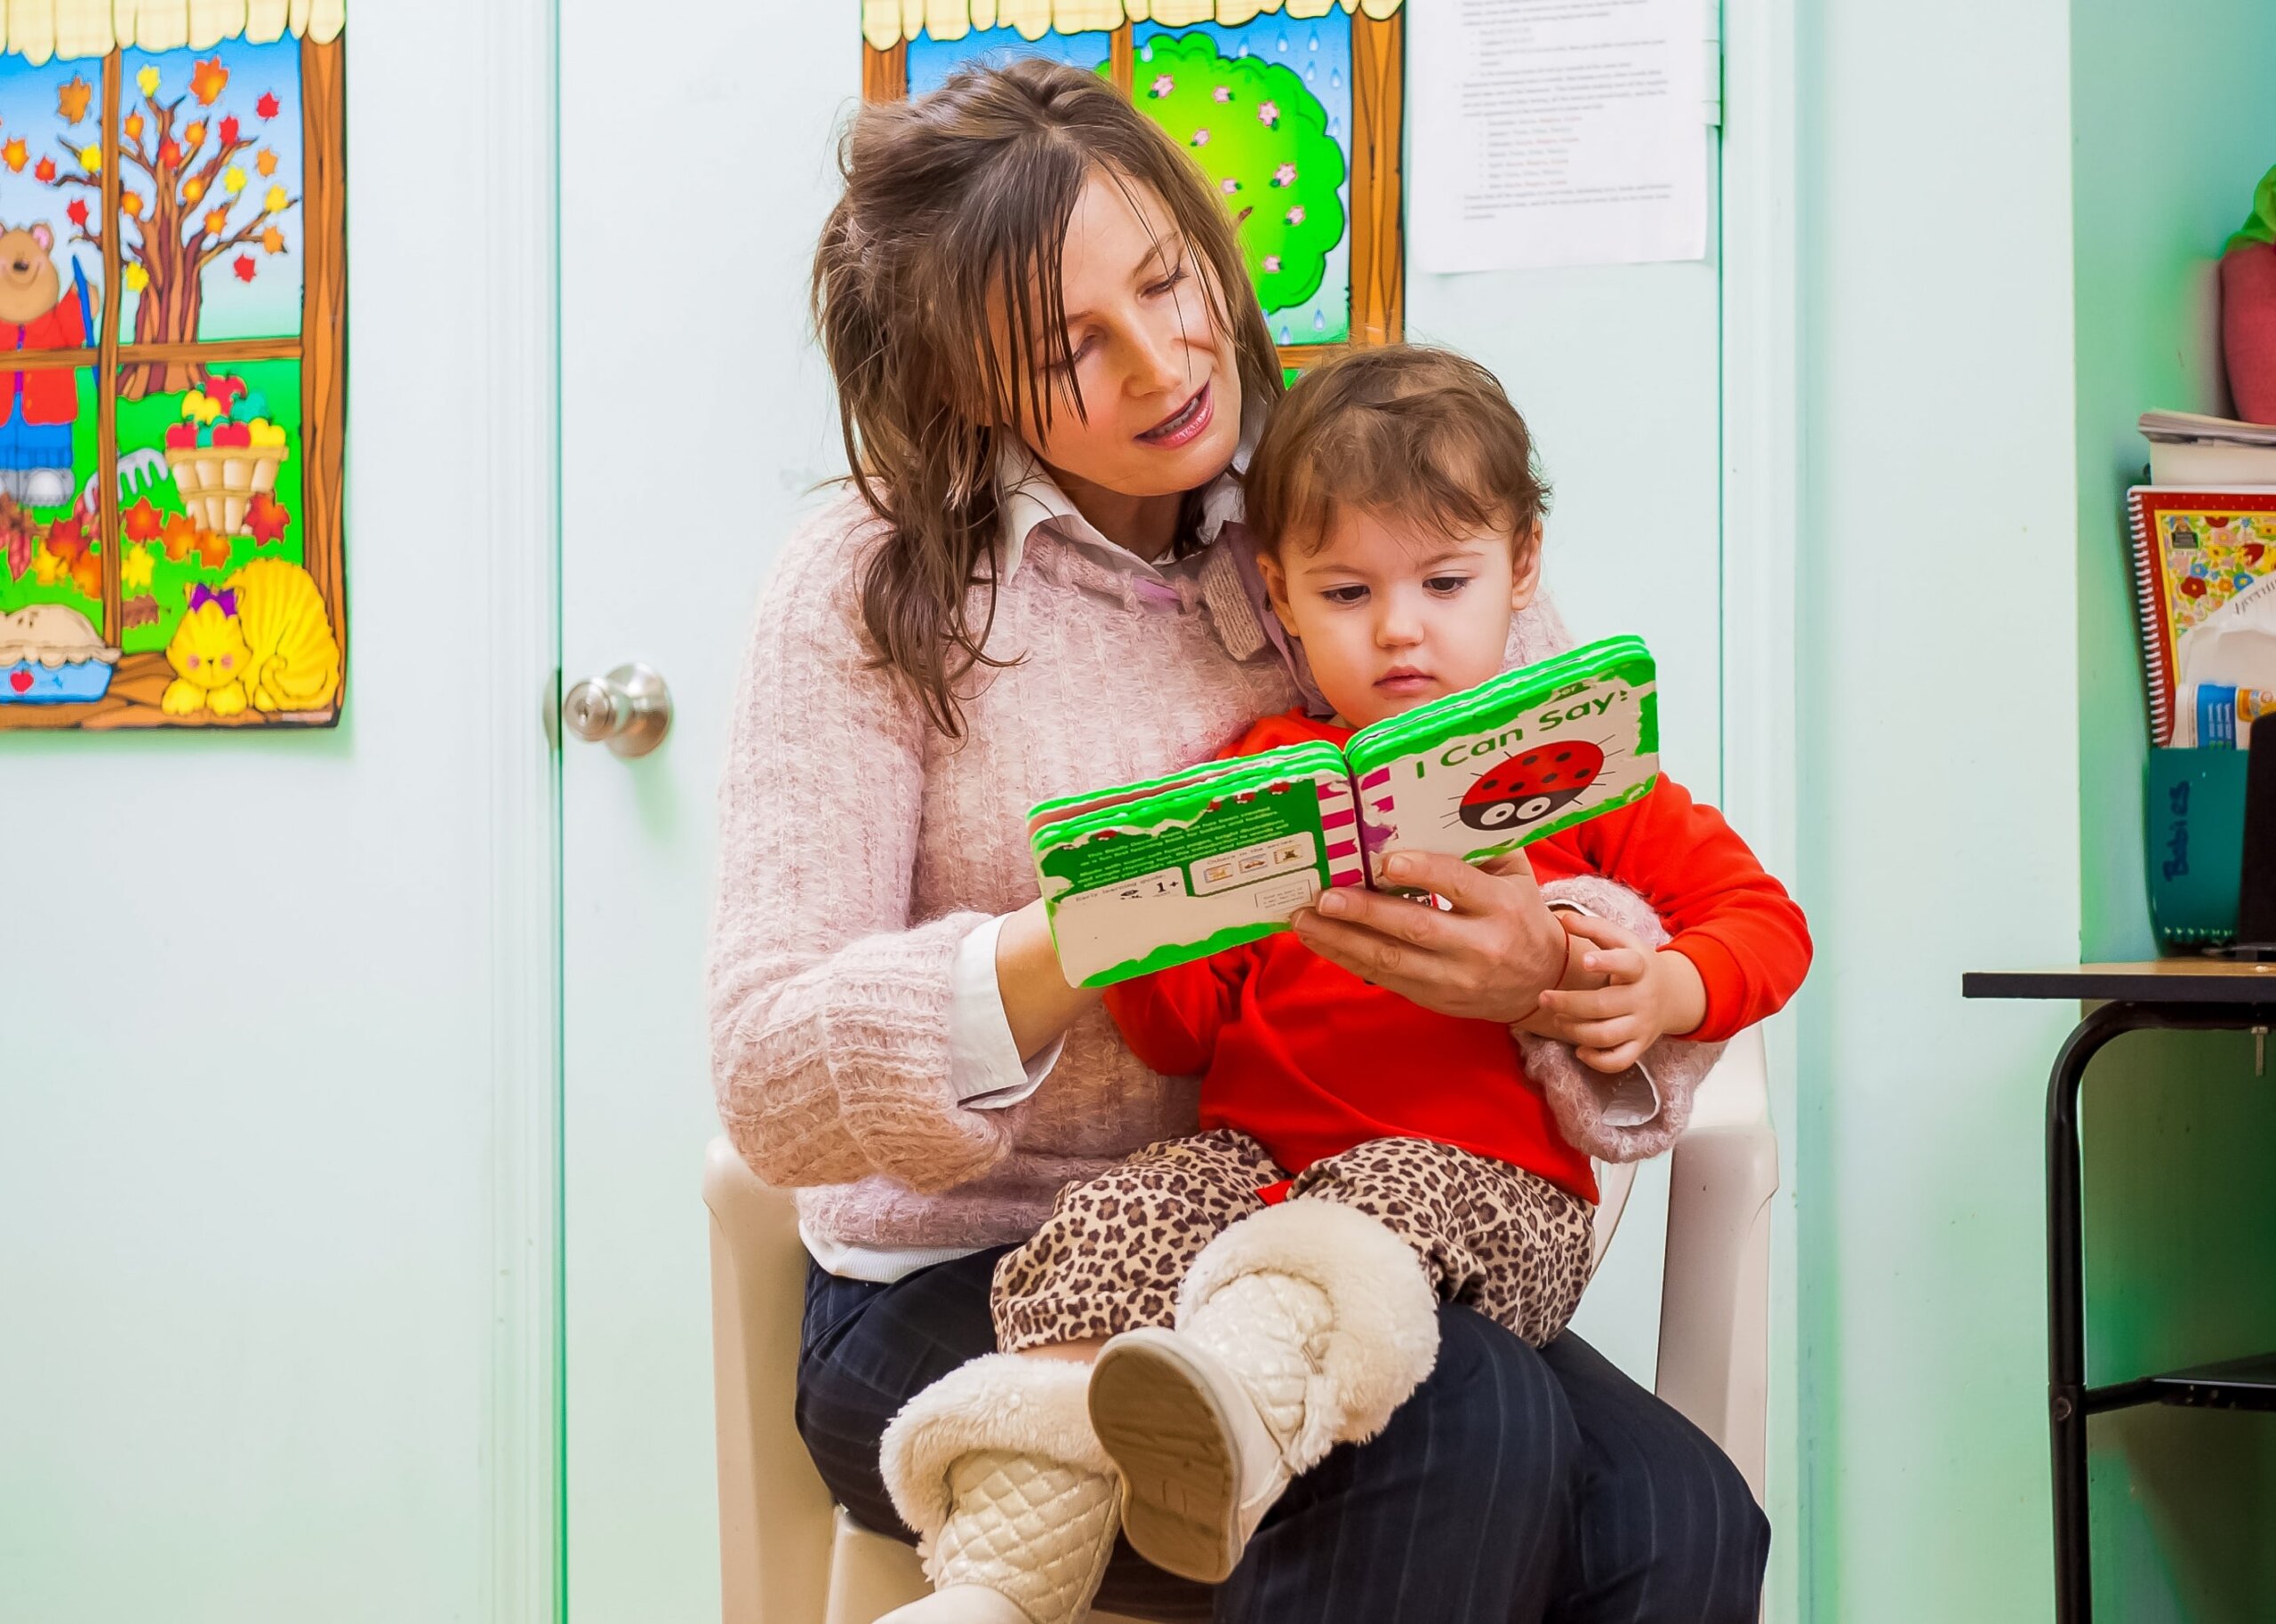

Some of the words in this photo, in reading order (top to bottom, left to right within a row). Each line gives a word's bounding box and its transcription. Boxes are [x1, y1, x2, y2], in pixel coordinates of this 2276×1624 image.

[1415, 761, 1424, 779] I
[1440, 728, 1523, 766] Can
[2161, 780, 2191, 882] Babies
